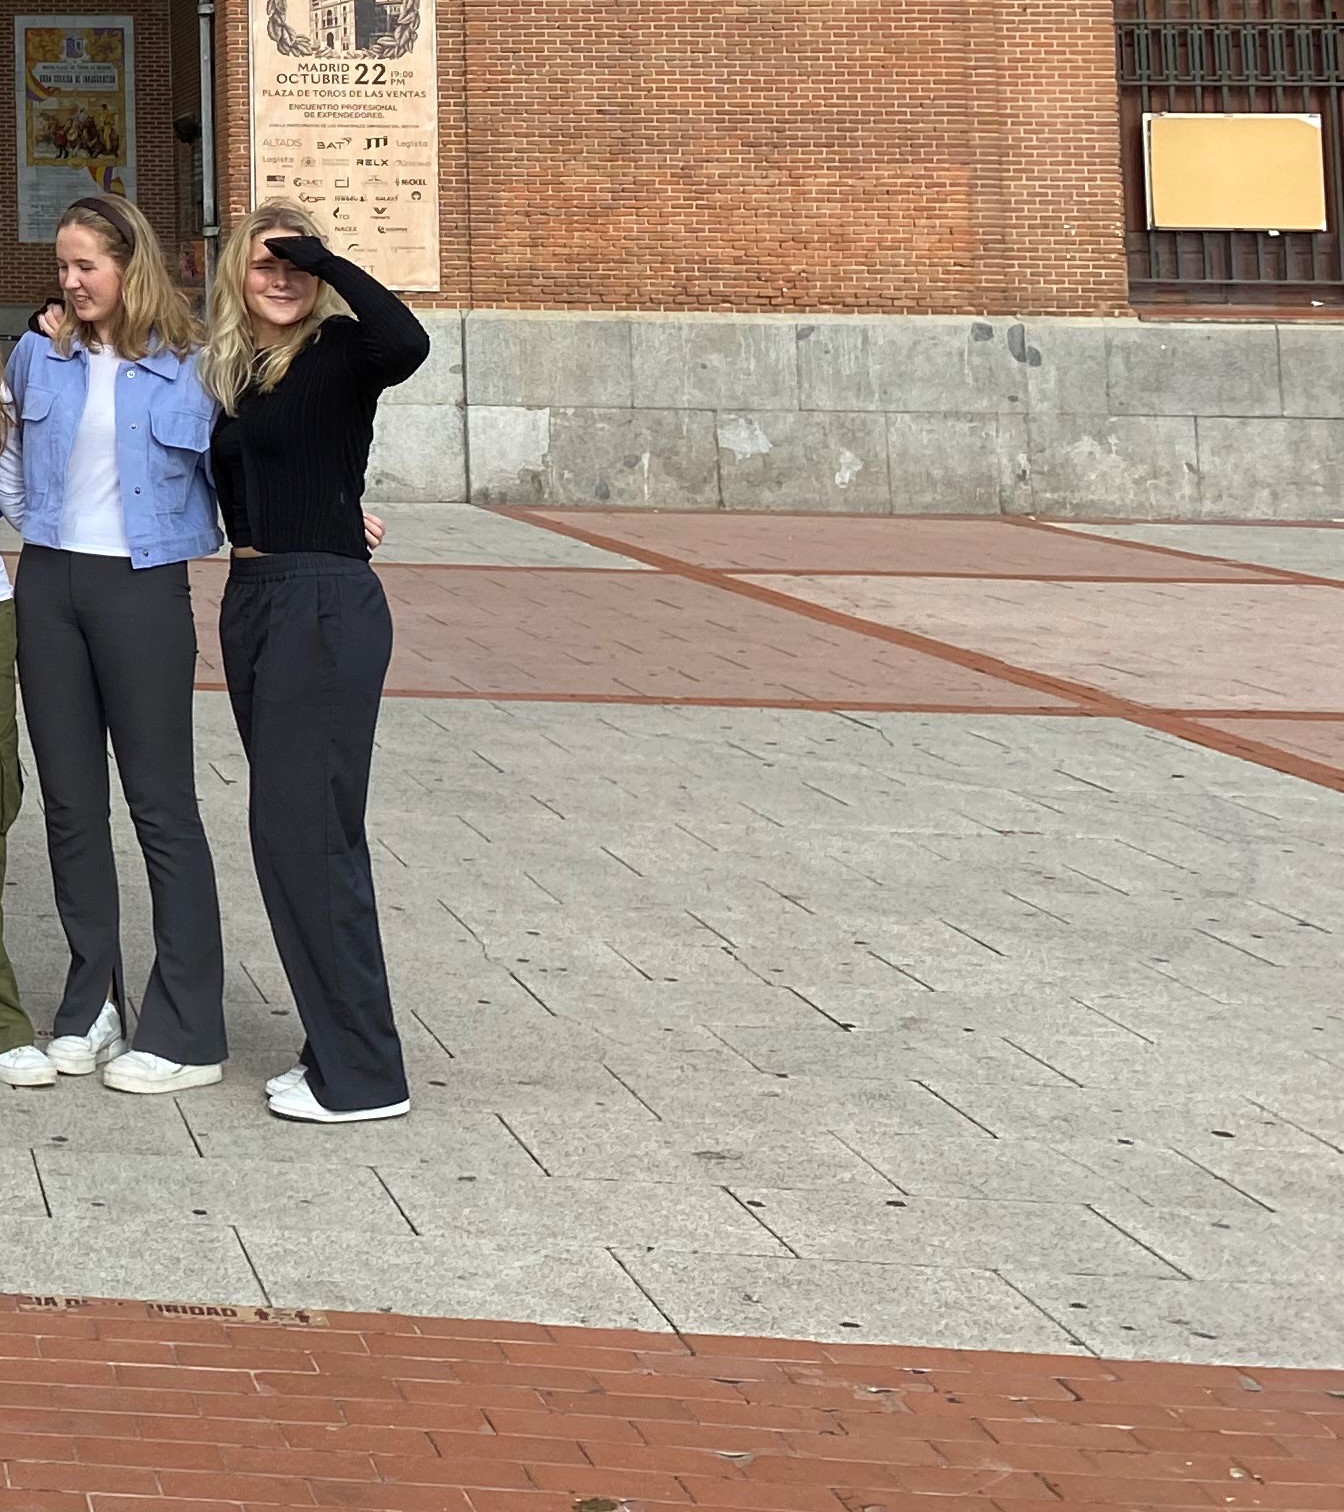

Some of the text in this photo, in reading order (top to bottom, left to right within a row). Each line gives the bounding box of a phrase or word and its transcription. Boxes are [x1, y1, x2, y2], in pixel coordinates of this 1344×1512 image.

[298, 63, 350, 72] MADRID
[354, 63, 387, 85] 22
[276, 74, 350, 84] OCTUBRE
[349, 90, 362, 98] DE
[365, 90, 383, 98] LAS
[386, 90, 426, 98] VENTAS
